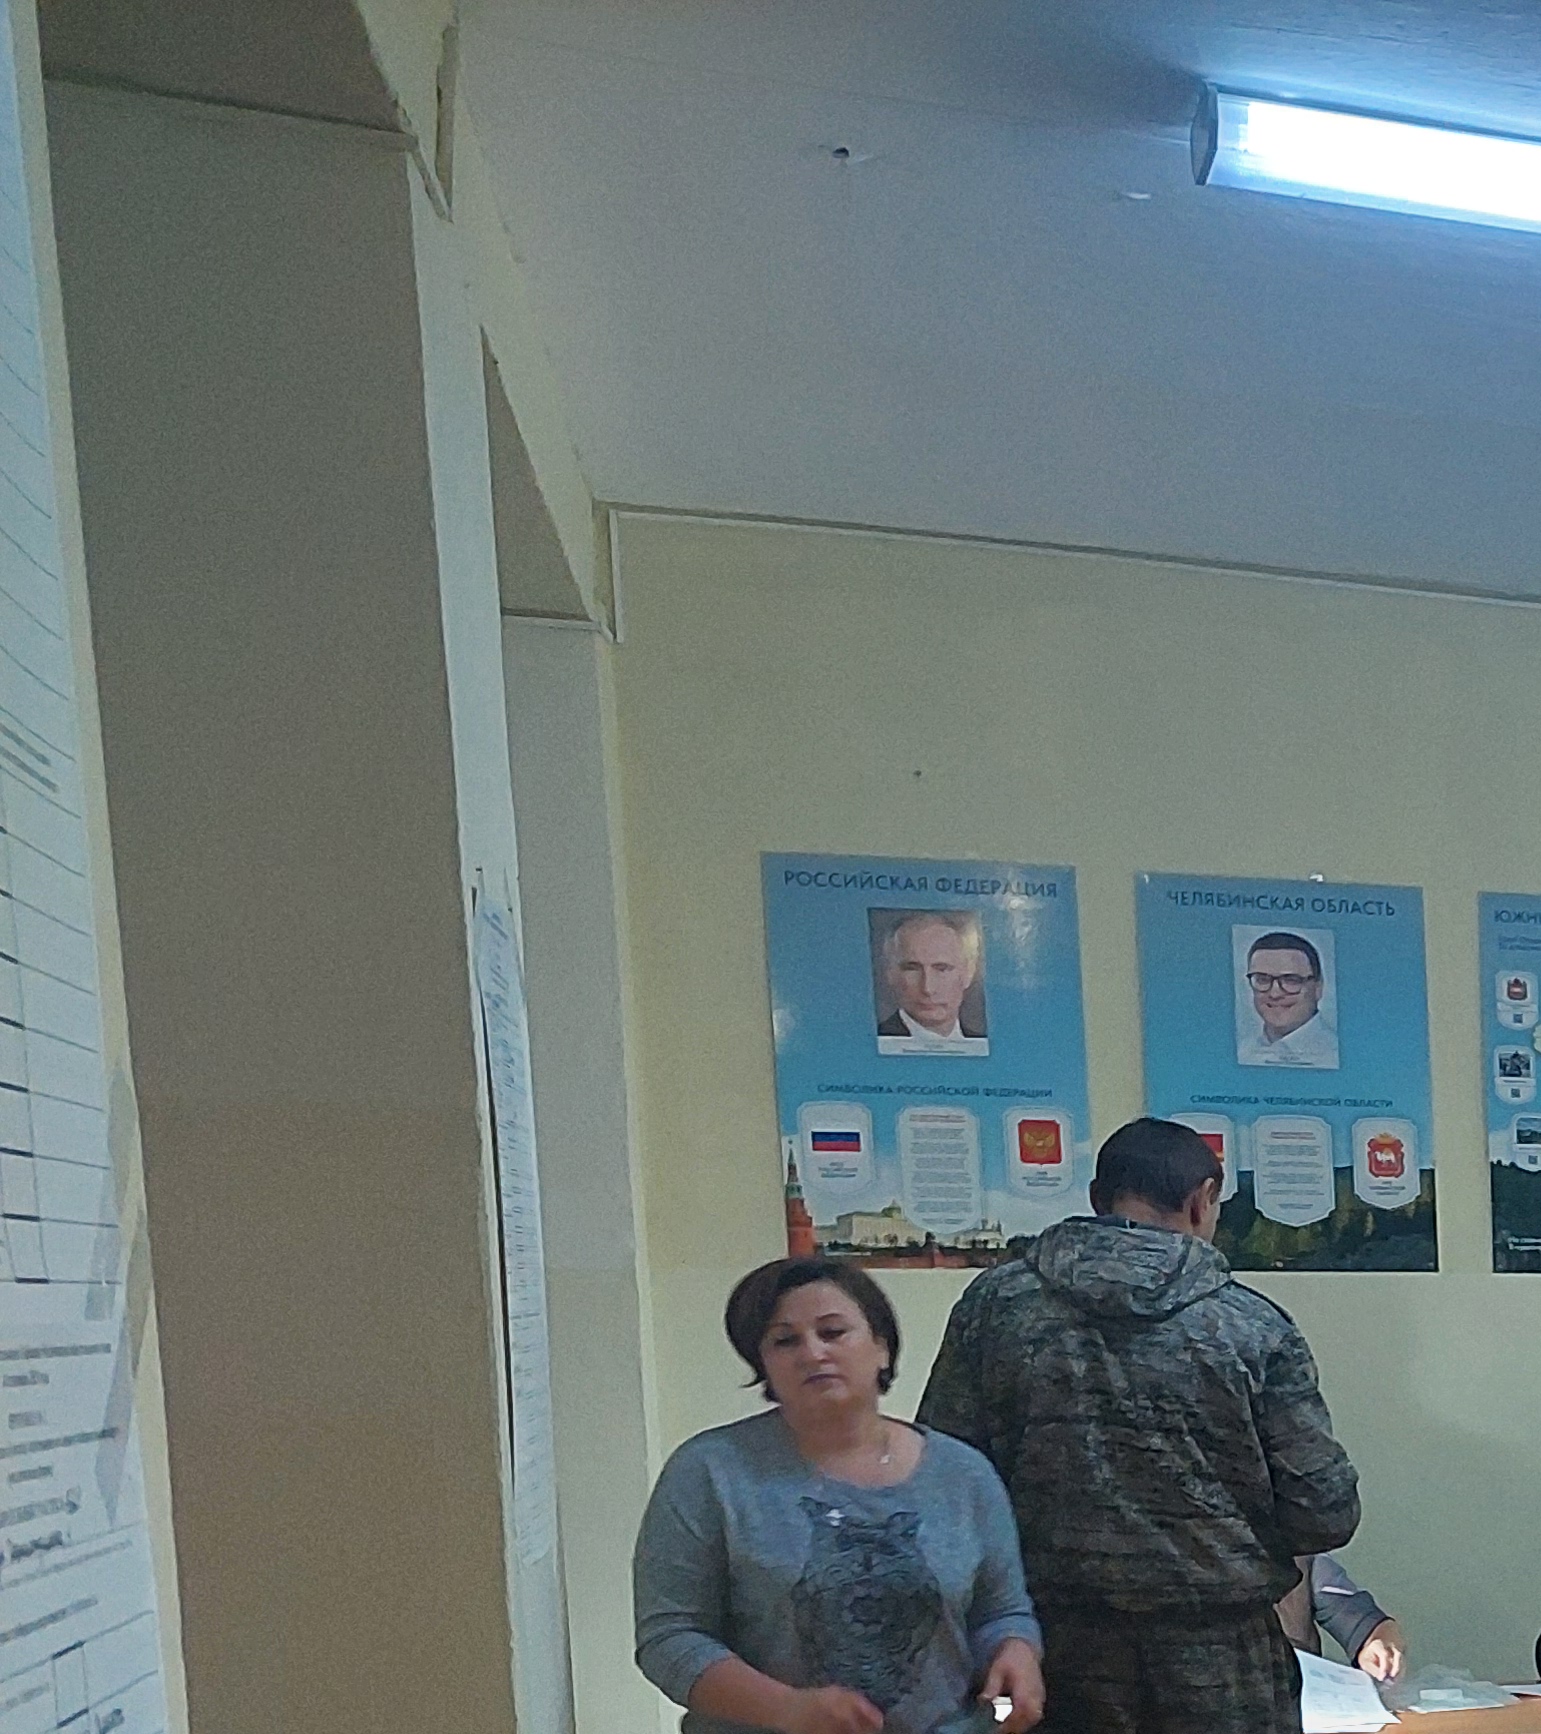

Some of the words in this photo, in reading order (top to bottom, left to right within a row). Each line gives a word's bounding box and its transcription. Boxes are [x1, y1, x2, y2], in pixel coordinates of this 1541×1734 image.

[784, 869, 928, 892] РОССИЙСКАЯ
[935, 878, 1058, 899] ФЕДЕРАЦИЯ
[1168, 890, 1304, 912] ЧЕЛЯБИНСКАЯ
[1311, 898, 1396, 917] ОБЛАСТЬ
[817, 1084, 893, 1095] СИМВОЛИКА
[898, 1085, 979, 1097] РОССИЙСКОЙ
[983, 1088, 1053, 1099] ФЕДЕРАЦИИ
[1190, 1095, 1259, 1104] СИМВОЛИКА
